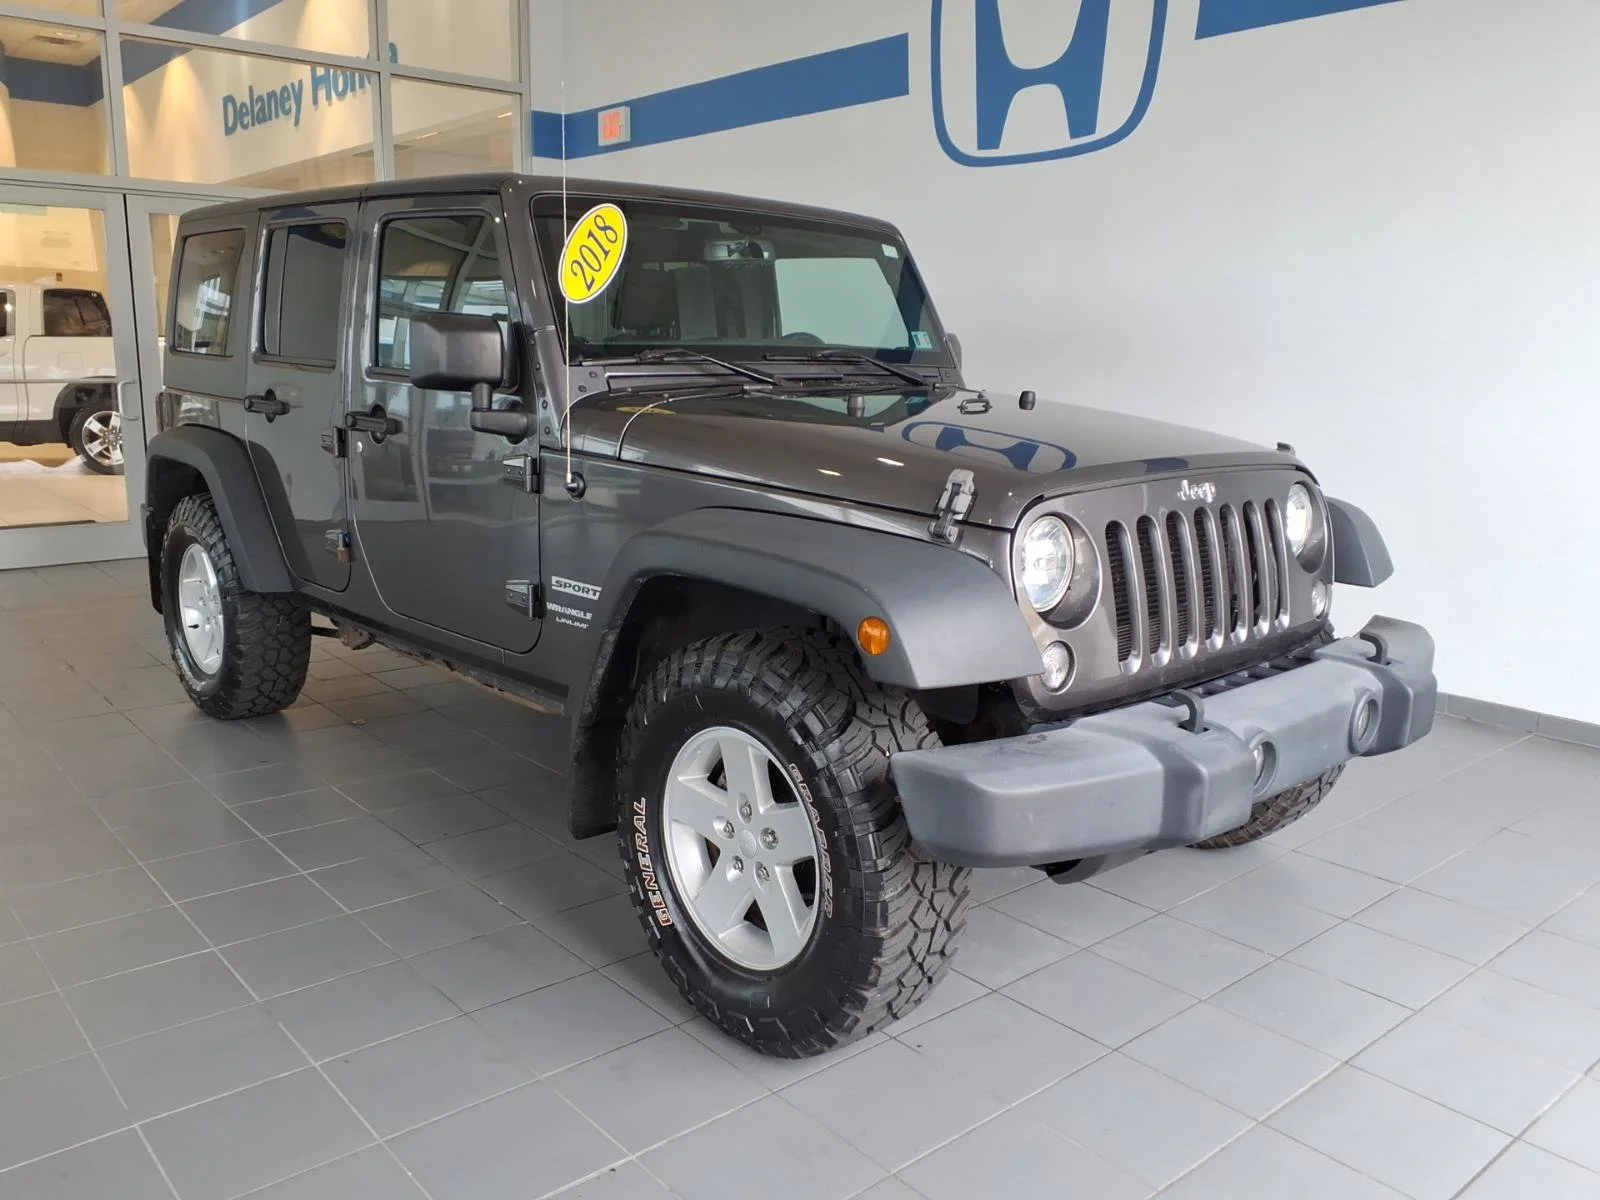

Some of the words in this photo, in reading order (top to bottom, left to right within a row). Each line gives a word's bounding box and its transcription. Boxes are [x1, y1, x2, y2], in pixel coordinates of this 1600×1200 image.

[222, 78, 303, 136] Delaney
[570, 214, 618, 292] 2018
[1177, 479, 1216, 503] Jeep
[554, 579, 600, 597] SPORT
[633, 797, 673, 927] GENERAL
